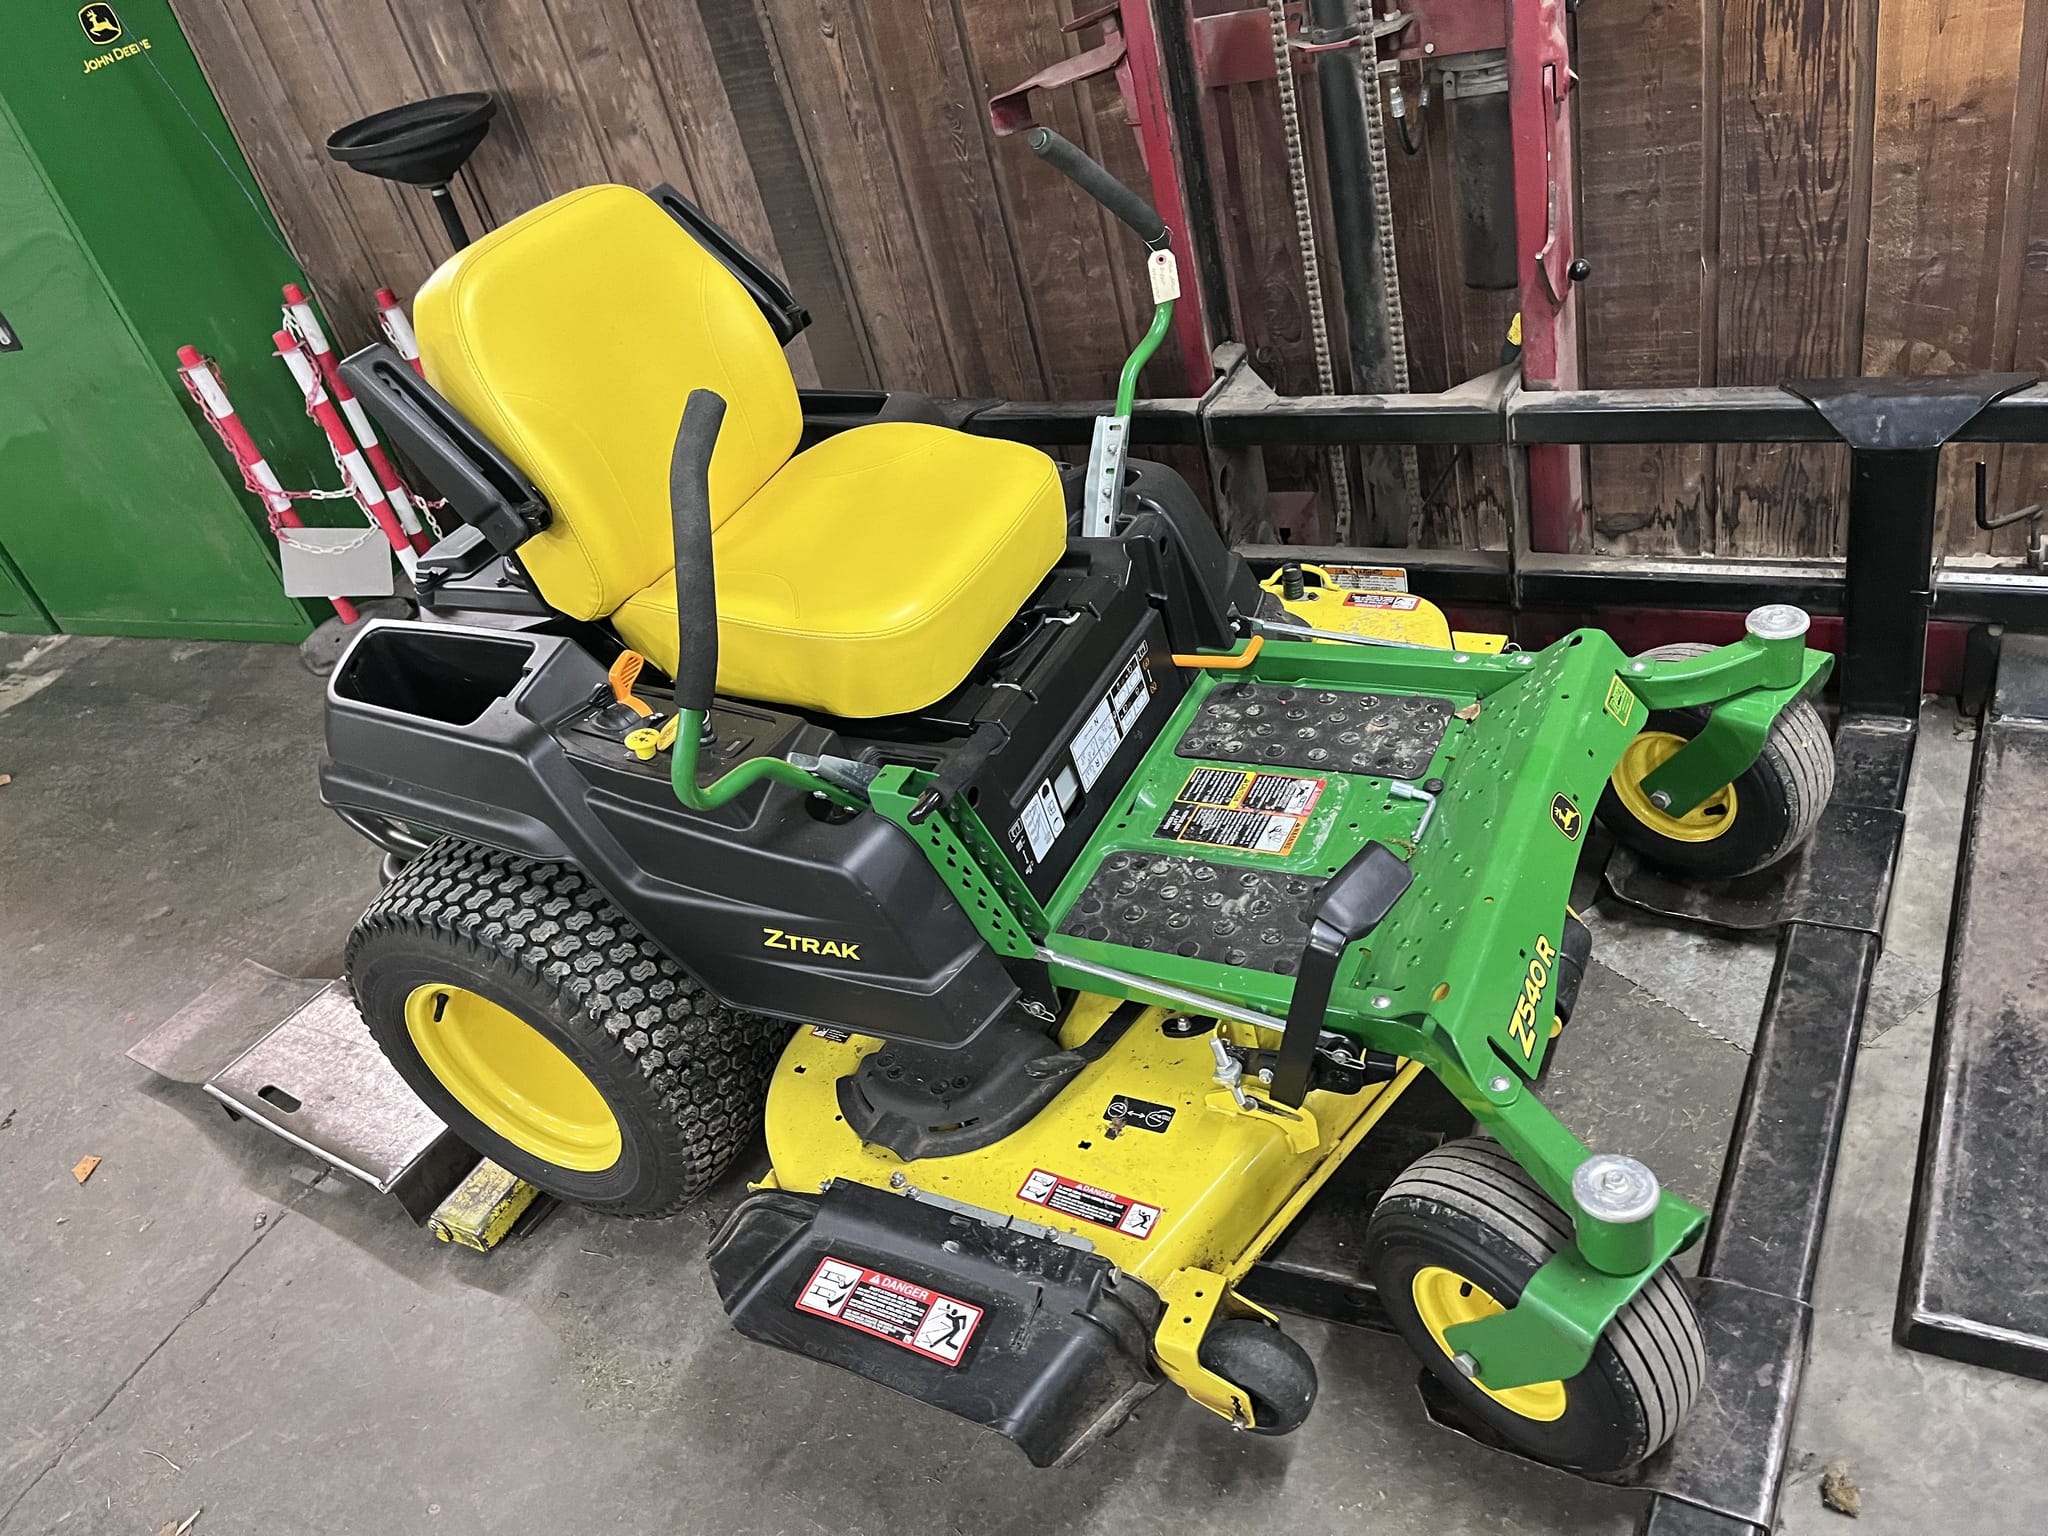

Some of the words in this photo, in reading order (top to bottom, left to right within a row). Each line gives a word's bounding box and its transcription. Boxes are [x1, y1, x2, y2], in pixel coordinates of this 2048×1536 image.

[84, 53, 115, 73] JOHN
[763, 928, 860, 961] ZTRAK
[1084, 1186, 1117, 1200] DANGER
[881, 1278, 929, 1299] DANGER
